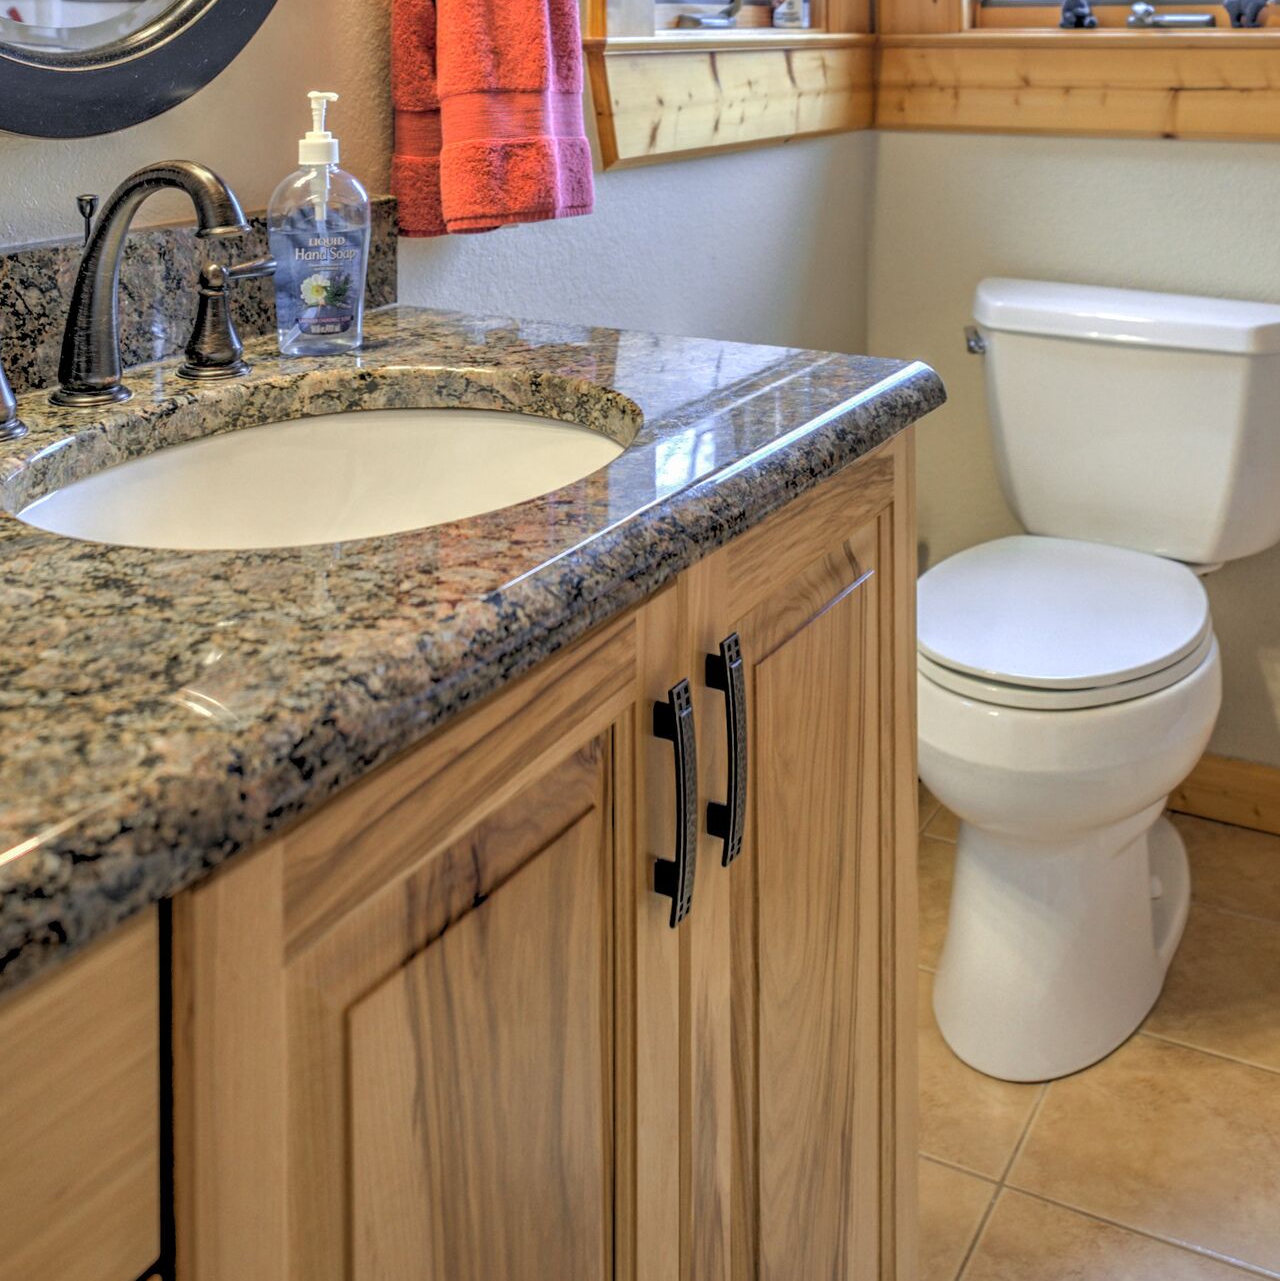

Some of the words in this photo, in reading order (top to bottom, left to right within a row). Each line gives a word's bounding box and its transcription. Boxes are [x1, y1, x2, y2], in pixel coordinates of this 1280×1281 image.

[308, 236, 346, 248] LIQUID
[295, 247, 328, 261] Hand
[329, 246, 357, 262] Soap
